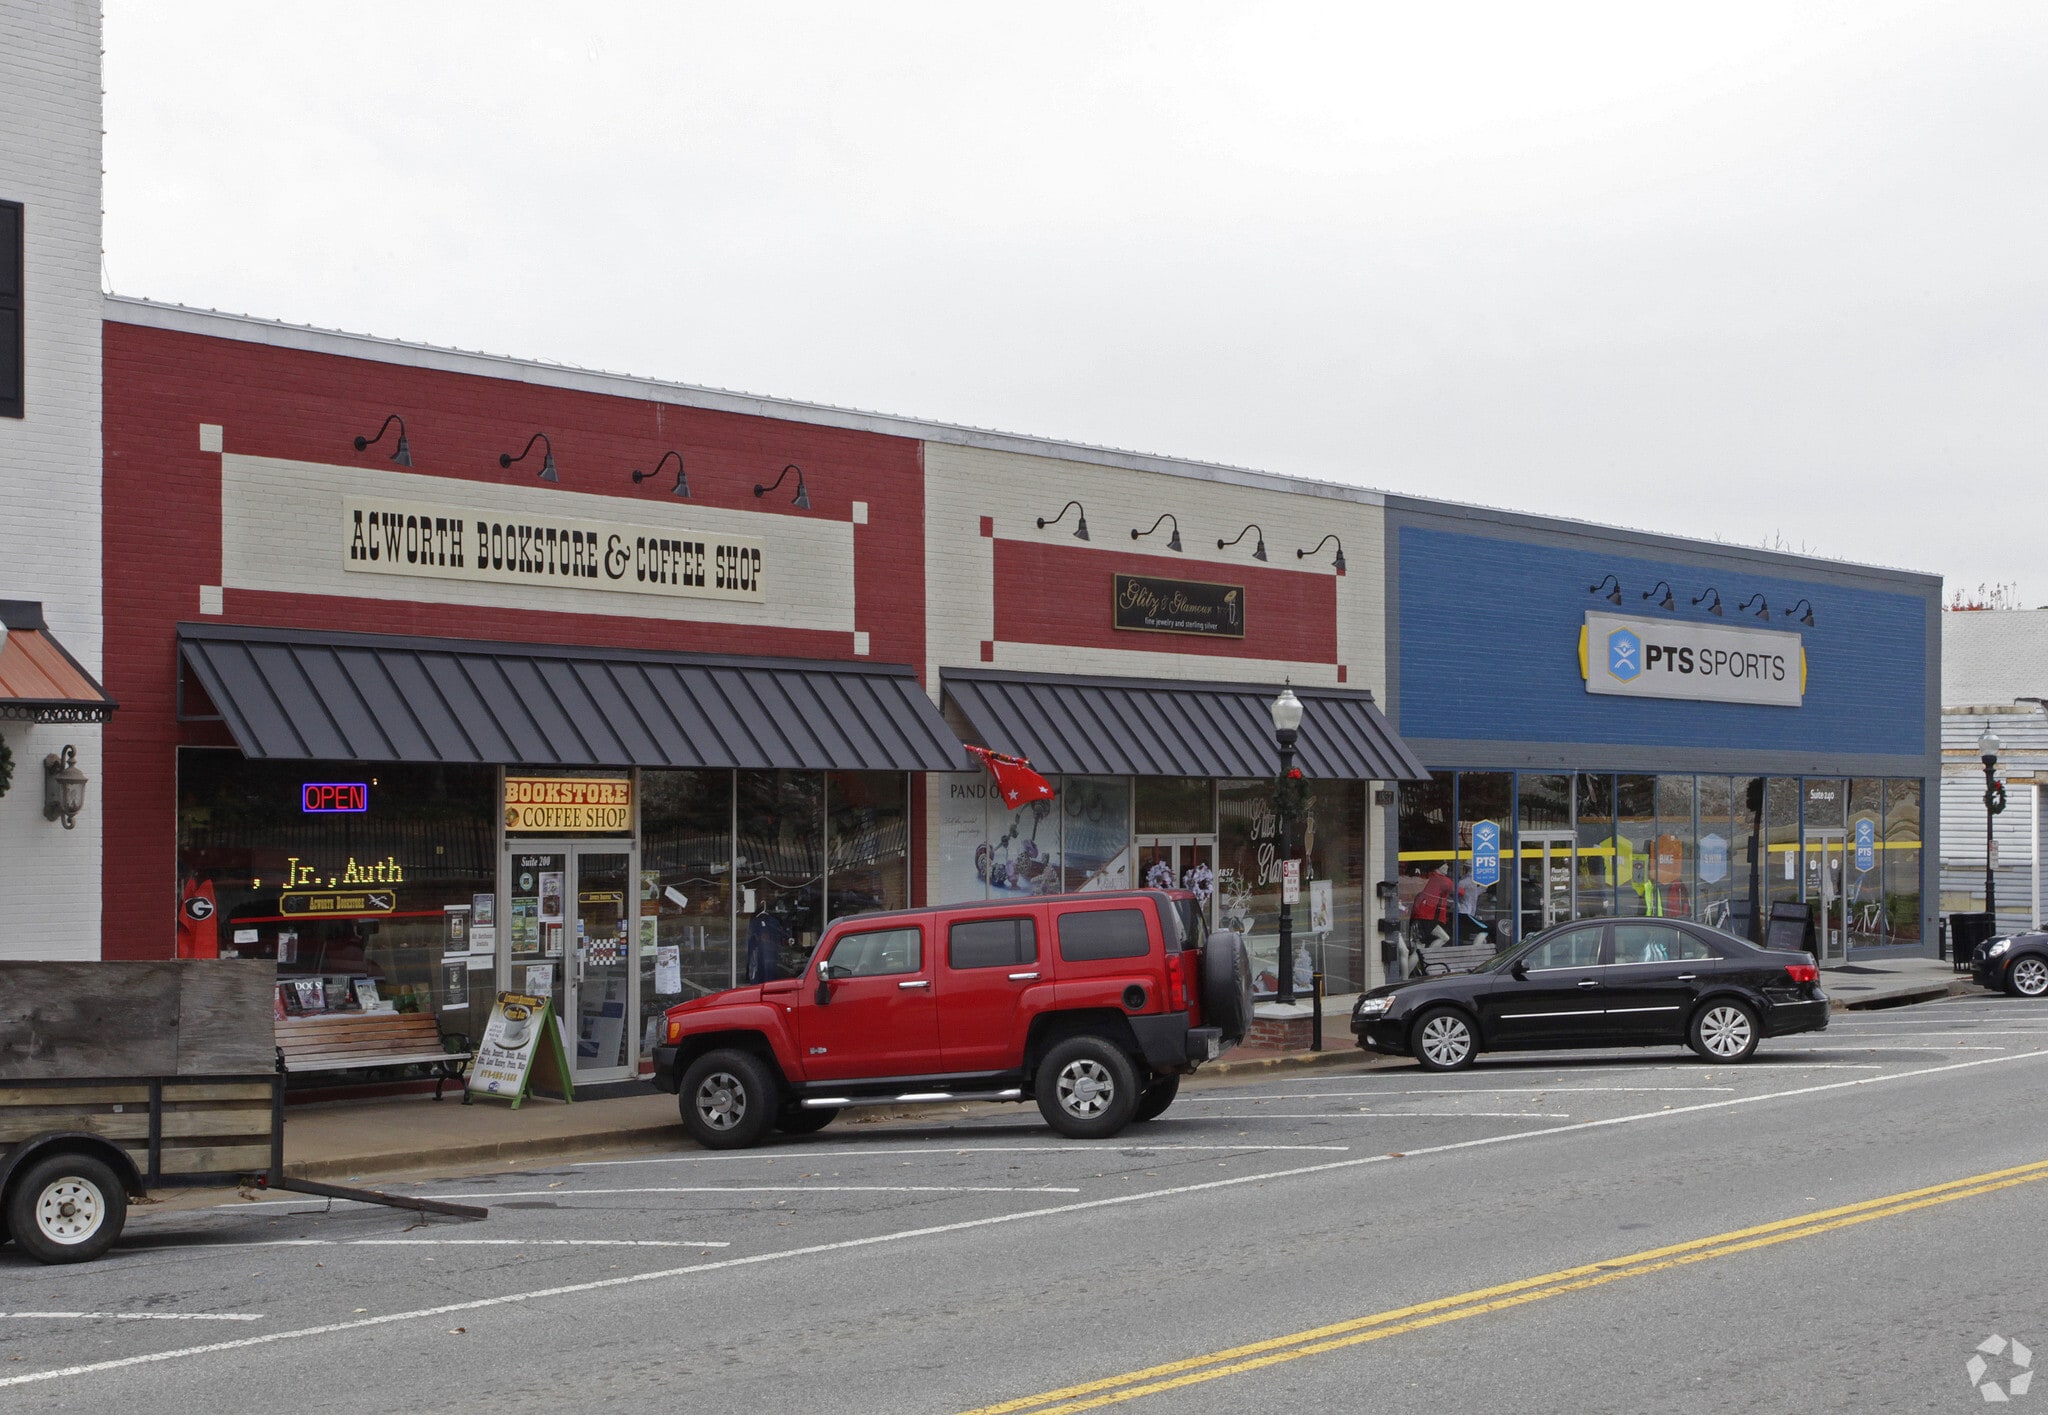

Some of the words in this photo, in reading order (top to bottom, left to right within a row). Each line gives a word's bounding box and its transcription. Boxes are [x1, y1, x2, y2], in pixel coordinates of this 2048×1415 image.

[351, 510, 464, 568] ACWORTH
[477, 521, 598, 578] BOOKSTORE
[604, 534, 630, 580] &
[637, 536, 705, 587] COFFEE
[716, 545, 760, 592] SHOP
[1120, 579, 1160, 617] Glitz
[1169, 590, 1212, 614] Glamour
[1145, 617, 1155, 625] fine
[1155, 618, 1174, 629] jewelry
[1175, 620, 1185, 628] and
[1185, 621, 1204, 631] sterling
[1204, 622, 1218, 630] silver
[1646, 644, 1694, 674] PTS
[1699, 649, 1785, 681] SPORTS
[305, 785, 364, 810] OPEN
[505, 782, 628, 804] BOOKSTORE
[950, 783, 1001, 799] PANDO
[1810, 789, 1825, 800] Suite
[1824, 791, 1835, 802] 240
[523, 807, 582, 827] COFFEE
[586, 808, 627, 828] SHOP
[1659, 854, 1674, 865] BIKE
[1704, 854, 1722, 864] SWIM
[1858, 847, 1872, 857] PTS
[521, 856, 538, 867] Suite
[539, 855, 551, 866] 200
[1258, 842, 1283, 886] Gla
[1476, 856, 1496, 867] PTS
[343, 856, 404, 883] Auth
[1476, 867, 1496, 875] SPORTS
